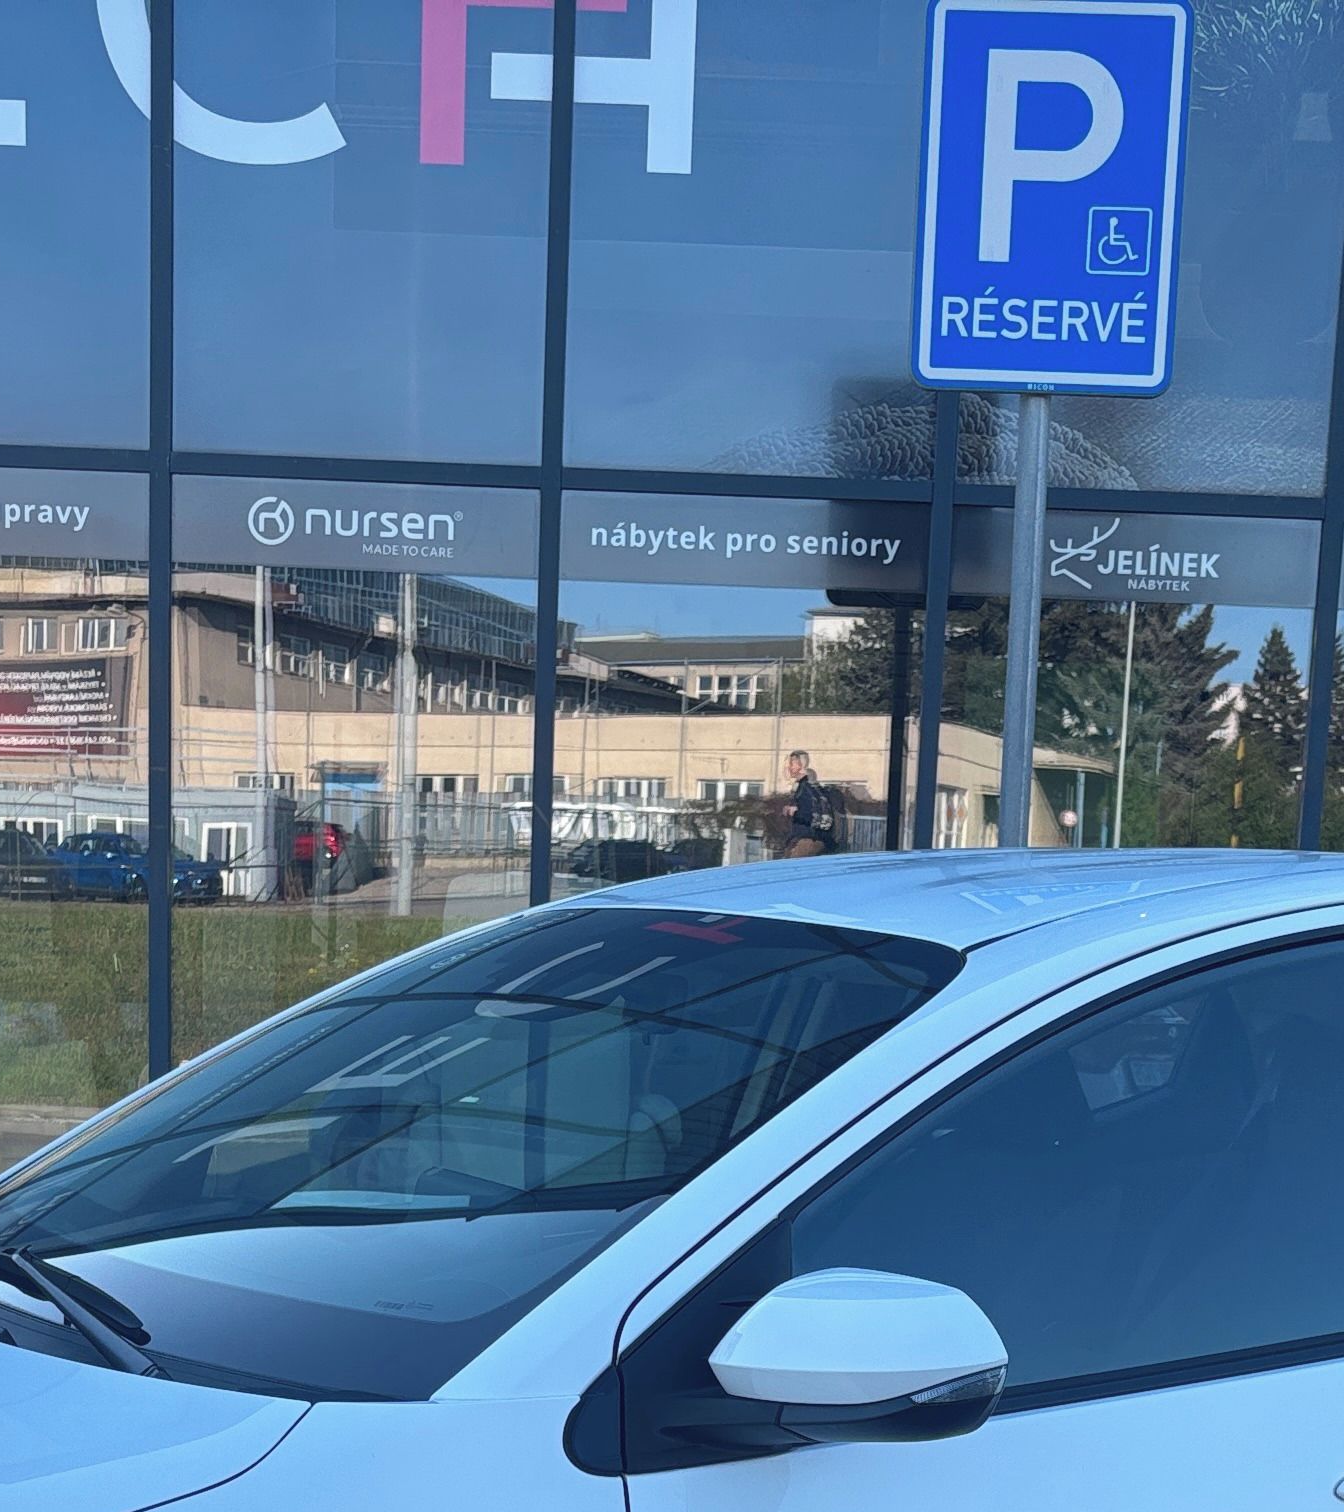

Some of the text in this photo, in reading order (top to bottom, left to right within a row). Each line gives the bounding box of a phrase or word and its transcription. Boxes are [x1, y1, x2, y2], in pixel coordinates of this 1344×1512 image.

[978, 48, 1124, 263] P
[940, 286, 1148, 343] RÉSERVÉ
[362, 543, 454, 558] MADE TO CARE
[590, 522, 901, 565] nábytek pro seniory
[1097, 543, 1221, 578] JELÍNEK
[1127, 577, 1190, 592] NÁBYTEK
